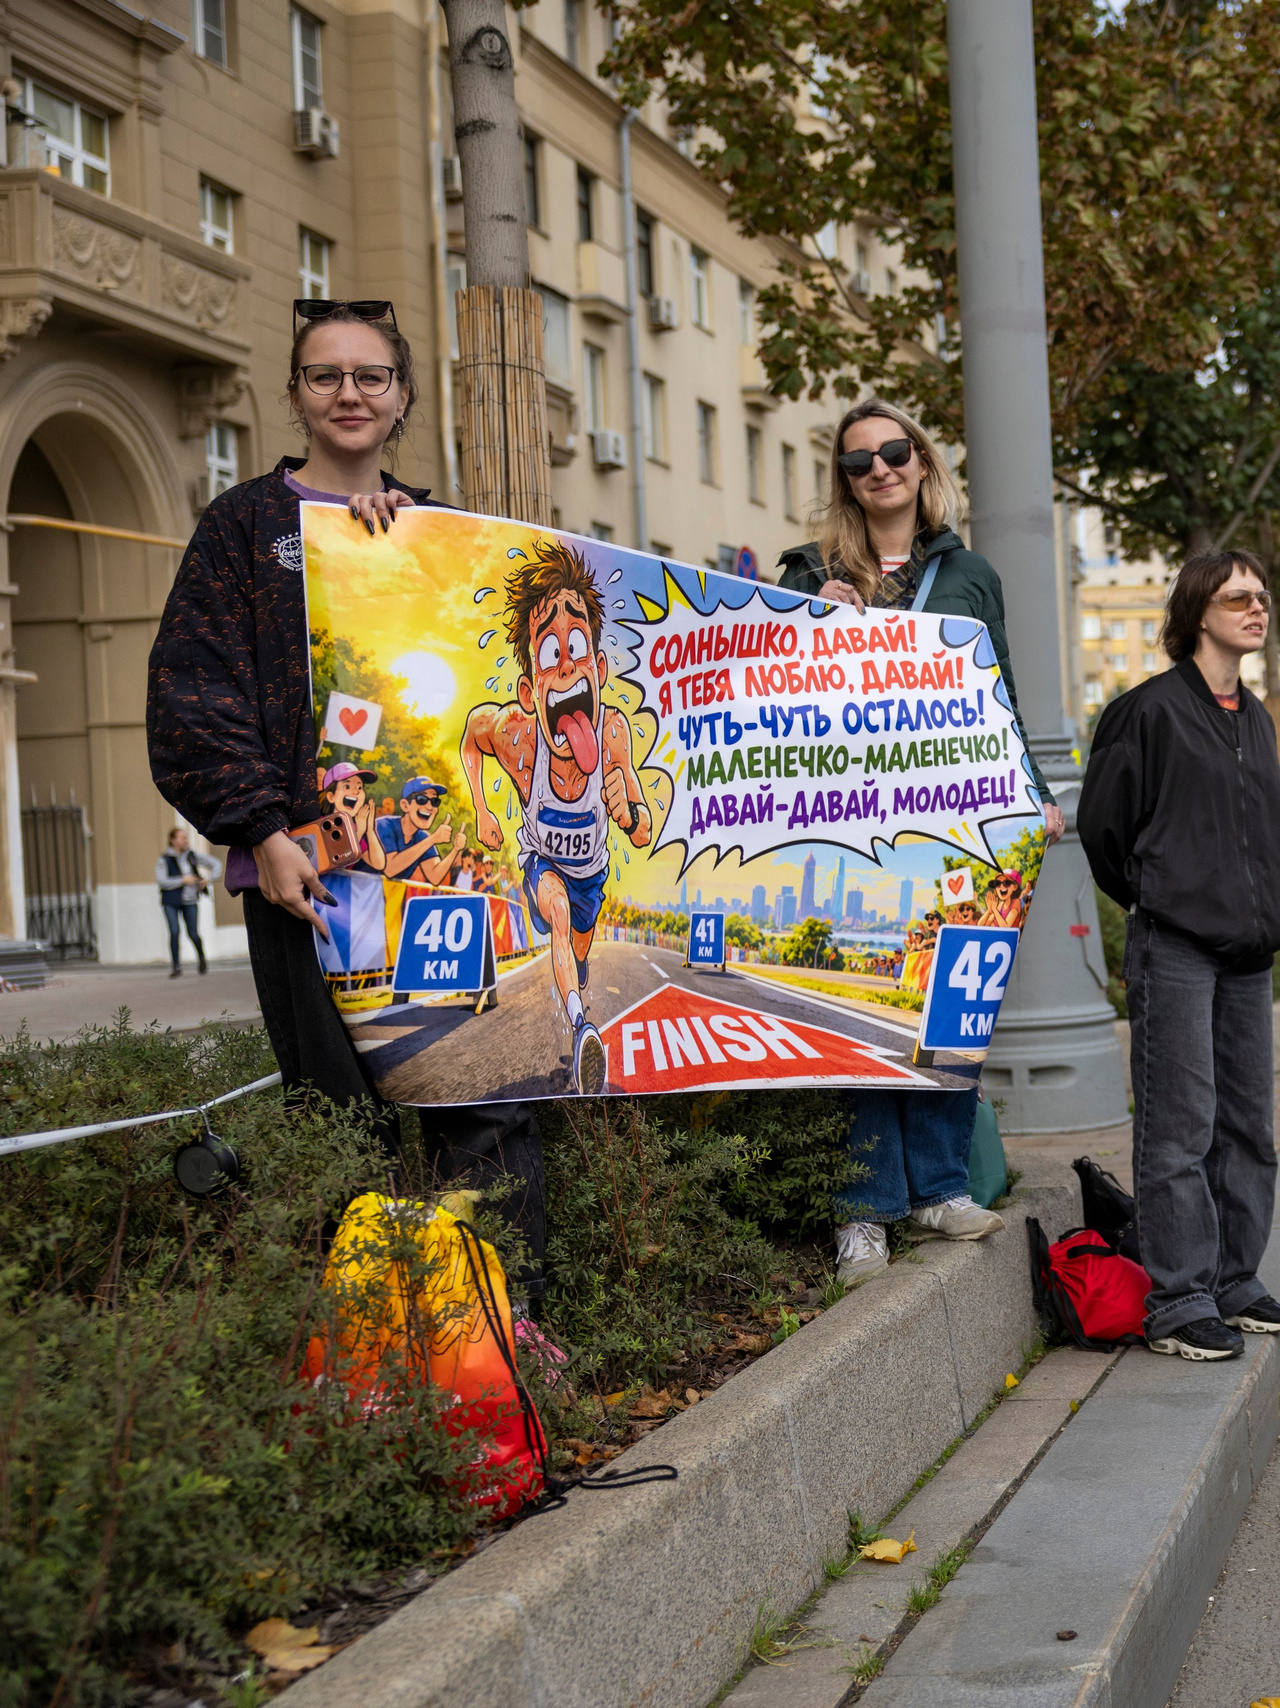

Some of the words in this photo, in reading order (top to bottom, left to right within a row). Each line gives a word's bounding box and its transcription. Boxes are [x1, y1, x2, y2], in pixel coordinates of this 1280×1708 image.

[649, 621, 805, 678] СОЛНЫШКО,
[811, 615, 916, 661] ДАВАЙ!
[658, 680, 673, 717] Я
[676, 668, 734, 710] ТЕБЯ
[744, 663, 855, 698] ЛЮБЛЮ,
[861, 649, 964, 695] ДАВАЙ!
[678, 702, 831, 751] ЧУТЬ-ЧУТЬ
[842, 688, 985, 735] ОСТАЛОСЬ!
[686, 727, 1009, 791] МАЛЕНЕЧКО-МАЛЕНЕЧКО!
[690, 778, 887, 839] ДАВАЙ-ДАВАЙ,
[892, 768, 1017, 816] МОЛОДЕЦ!
[544, 830, 591, 857] 42195
[413, 907, 473, 953] 40
[694, 918, 715, 943] 41
[698, 946, 713, 958] KM
[423, 959, 458, 981] KM
[946, 941, 1012, 1002] 42
[621, 1014, 824, 1077] FINISH
[960, 1013, 993, 1037] KM
